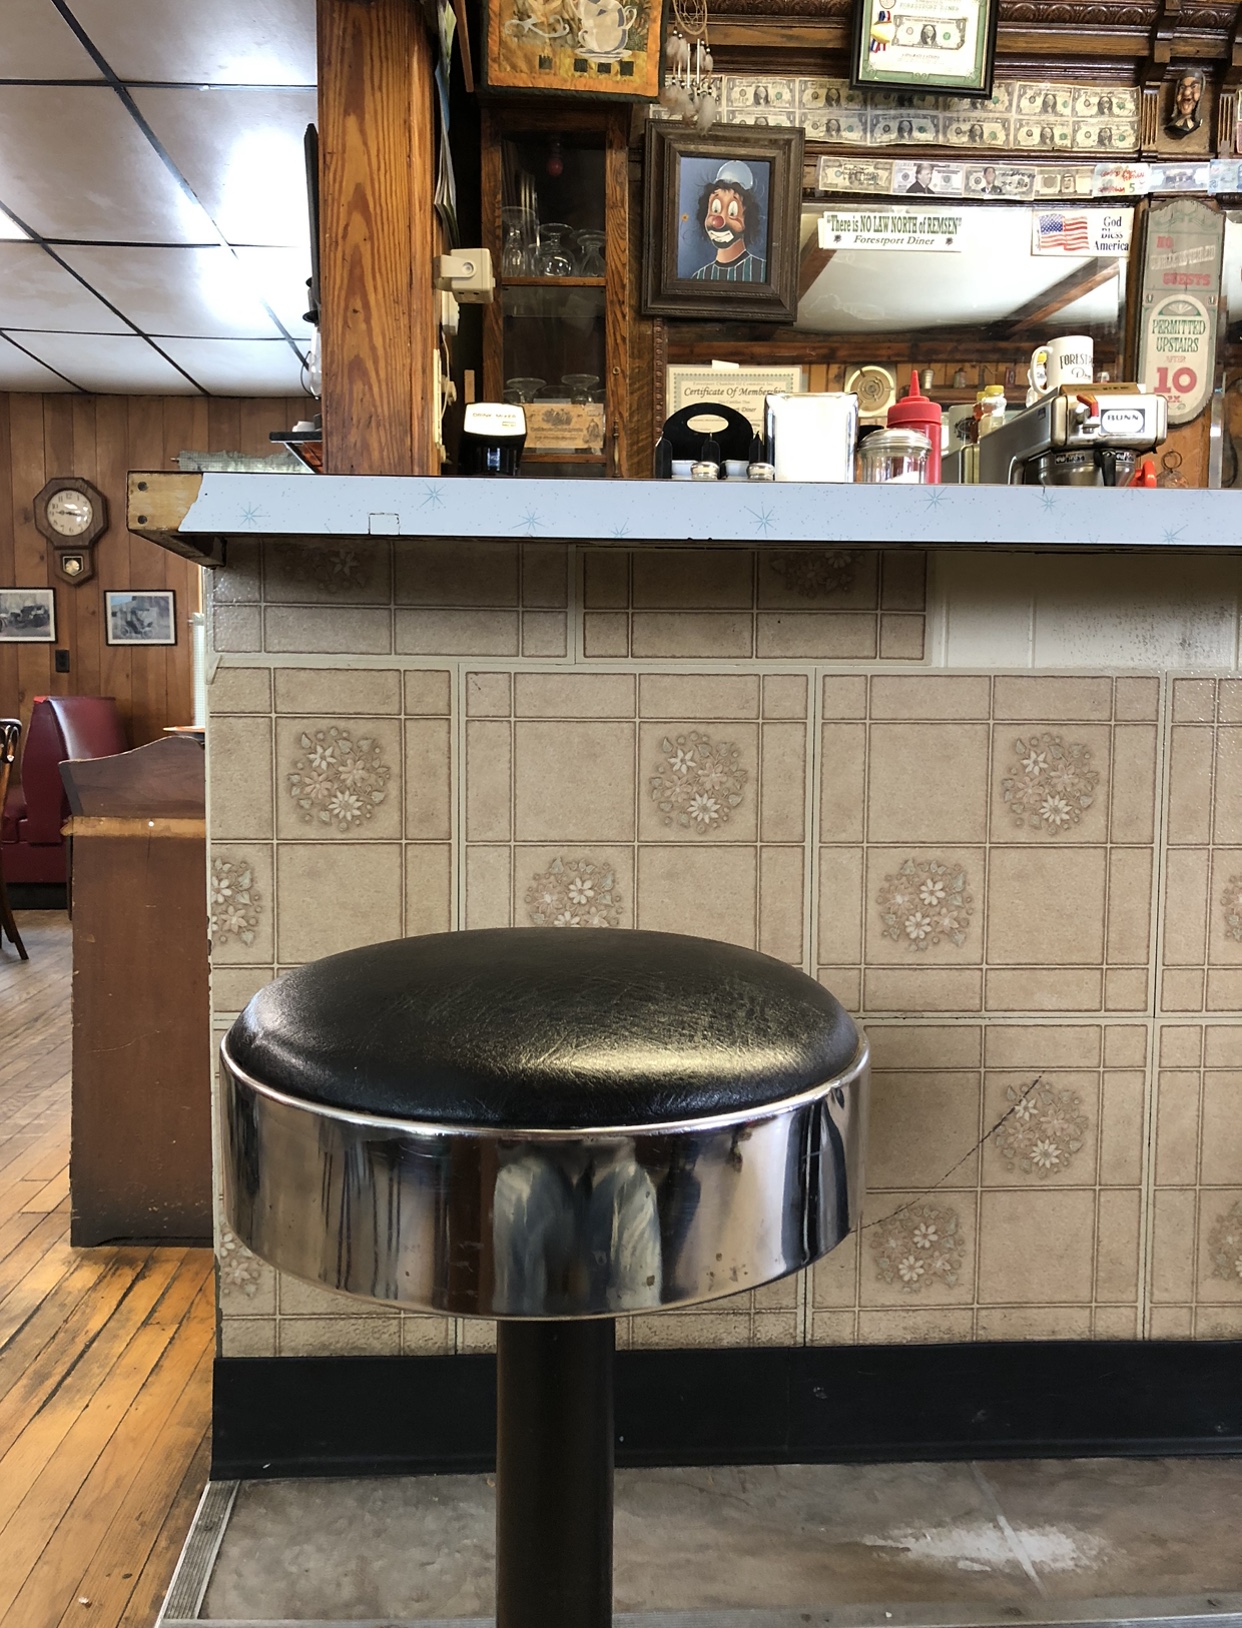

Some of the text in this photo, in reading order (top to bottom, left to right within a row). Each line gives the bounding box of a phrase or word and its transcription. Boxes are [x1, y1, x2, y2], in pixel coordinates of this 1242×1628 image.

[852, 216, 859, 232] is
[860, 215, 872, 232] NO
[873, 216, 890, 233] LAW
[891, 216, 917, 233] NORTH
[919, 217, 927, 233] of
[1103, 216, 1122, 227] God
[853, 235, 935, 246] Forestport Diner
[1101, 228, 1123, 239] Bless
[1095, 240, 1129, 251] America
[1156, 235, 1174, 249] NO
[1162, 272, 1211, 287] GUESTS
[1152, 319, 1206, 335] PERMITTED
[1156, 337, 1199, 352] UPSTAIRS
[1153, 367, 1197, 394] 10
[684, 386, 725, 398] Certificate
[726, 386, 739, 398] Of
